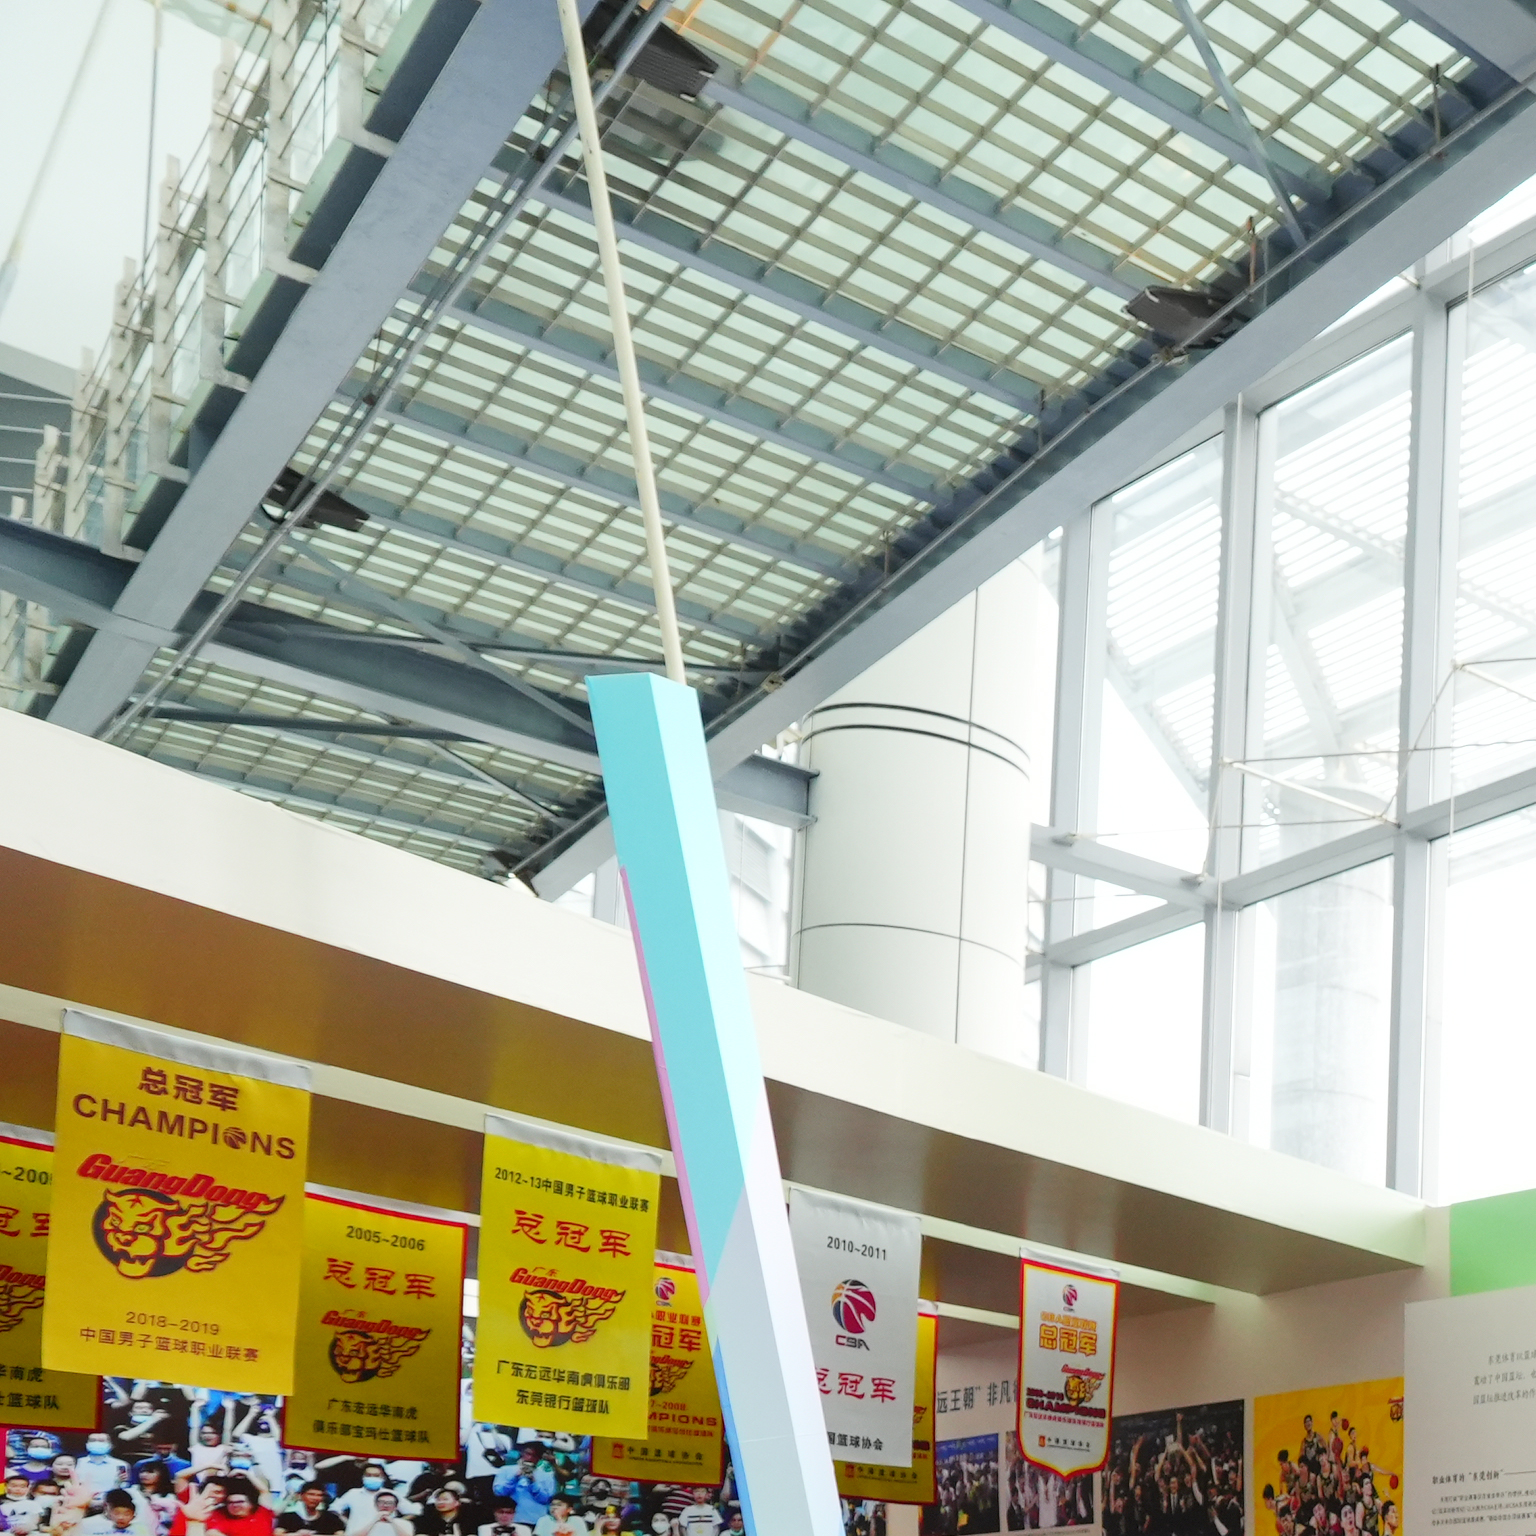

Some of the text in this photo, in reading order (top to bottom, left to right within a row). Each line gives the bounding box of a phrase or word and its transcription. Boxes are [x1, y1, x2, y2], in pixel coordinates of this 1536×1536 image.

[138, 1066, 240, 1112] 总冠军
[2, 1167, 53, 1186] ~200
[76, 1152, 272, 1212] GuangDong
[494, 1166, 650, 1213] 2012~13中国男子篮球职业联赛
[346, 1225, 426, 1251] 2005~2006
[511, 1209, 631, 1258] 总冠军
[827, 1236, 887, 1261] 2010~2011
[323, 1257, 437, 1300] 总冠军
[510, 1267, 619, 1301] GuangDong
[321, 1310, 422, 1340] GuangDong
[1039, 1324, 1097, 1356] 总冠军
[79, 1326, 260, 1363] 中国男子篮球职业联赛
[835, 1334, 870, 1350] CBA
[497, 1360, 631, 1391] 广东宏远华南虎俱乐部
[0, 1391, 59, 1410] 篮球队
[516, 1389, 610, 1415] 东莞银行篮球队
[986, 1379, 1017, 1406] 非凡
[327, 1398, 418, 1420] 广东宏远华南虎
